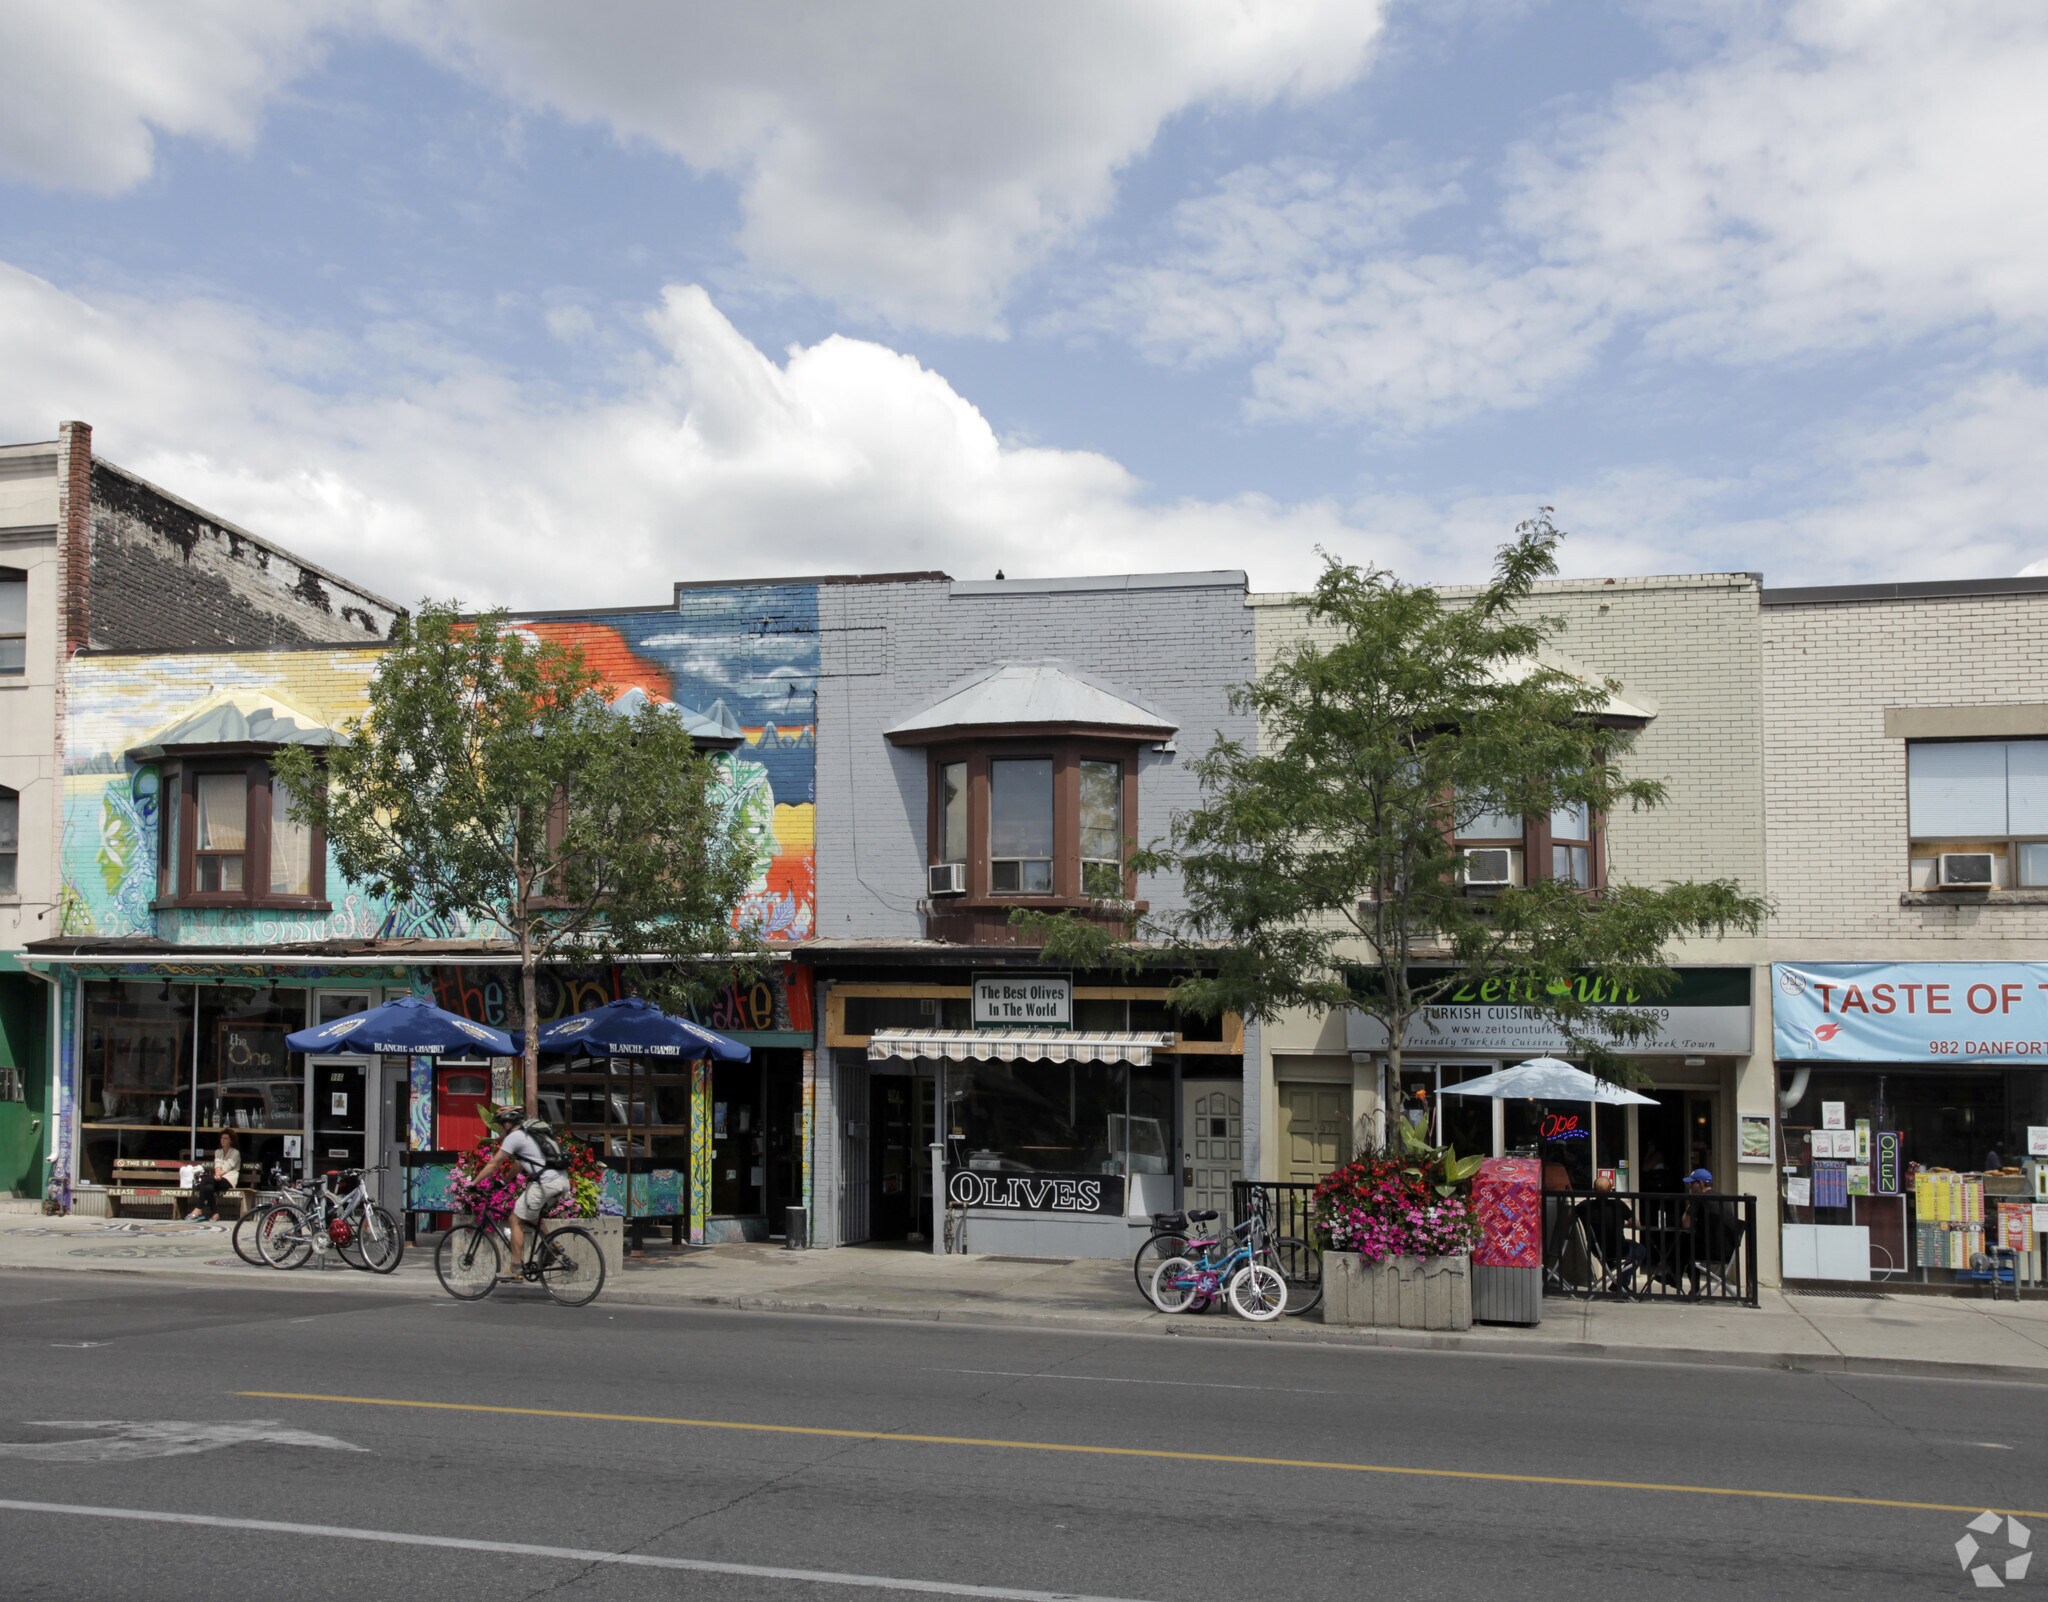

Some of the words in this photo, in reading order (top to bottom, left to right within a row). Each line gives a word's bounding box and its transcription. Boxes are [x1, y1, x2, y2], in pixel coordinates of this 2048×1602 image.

[981, 985, 1000, 1000] The
[1003, 985, 1028, 1000] Best
[1030, 985, 1065, 1000] Olives
[1813, 983, 1952, 1015] TASTE
[1966, 983, 2024, 1015] OF
[989, 1002, 1000, 1017] In
[1002, 1002, 1023, 1017] The
[1025, 1002, 1057, 1017] World
[1423, 1007, 1482, 1020] TURKISH
[229, 1033, 247, 1046] the
[1406, 1037, 1457, 1047] friendly
[1460, 1037, 1507, 1047] Turkish
[1511, 1038, 1554, 1047] Cuisine
[1681, 1039, 1716, 1049] Town
[228, 1045, 271, 1065] One
[374, 1042, 408, 1053] BLANCHE
[415, 1044, 446, 1054] CHAMBLY
[609, 1043, 644, 1054] BLANCHE
[650, 1045, 681, 1056] CHAMBLY
[1929, 1041, 1960, 1055] 982
[1881, 1135, 1896, 1191] OPEN
[108, 1188, 135, 1196] PLEASE
[160, 1189, 181, 1197] SMOKE
[950, 1171, 1101, 1212] OLIVES
